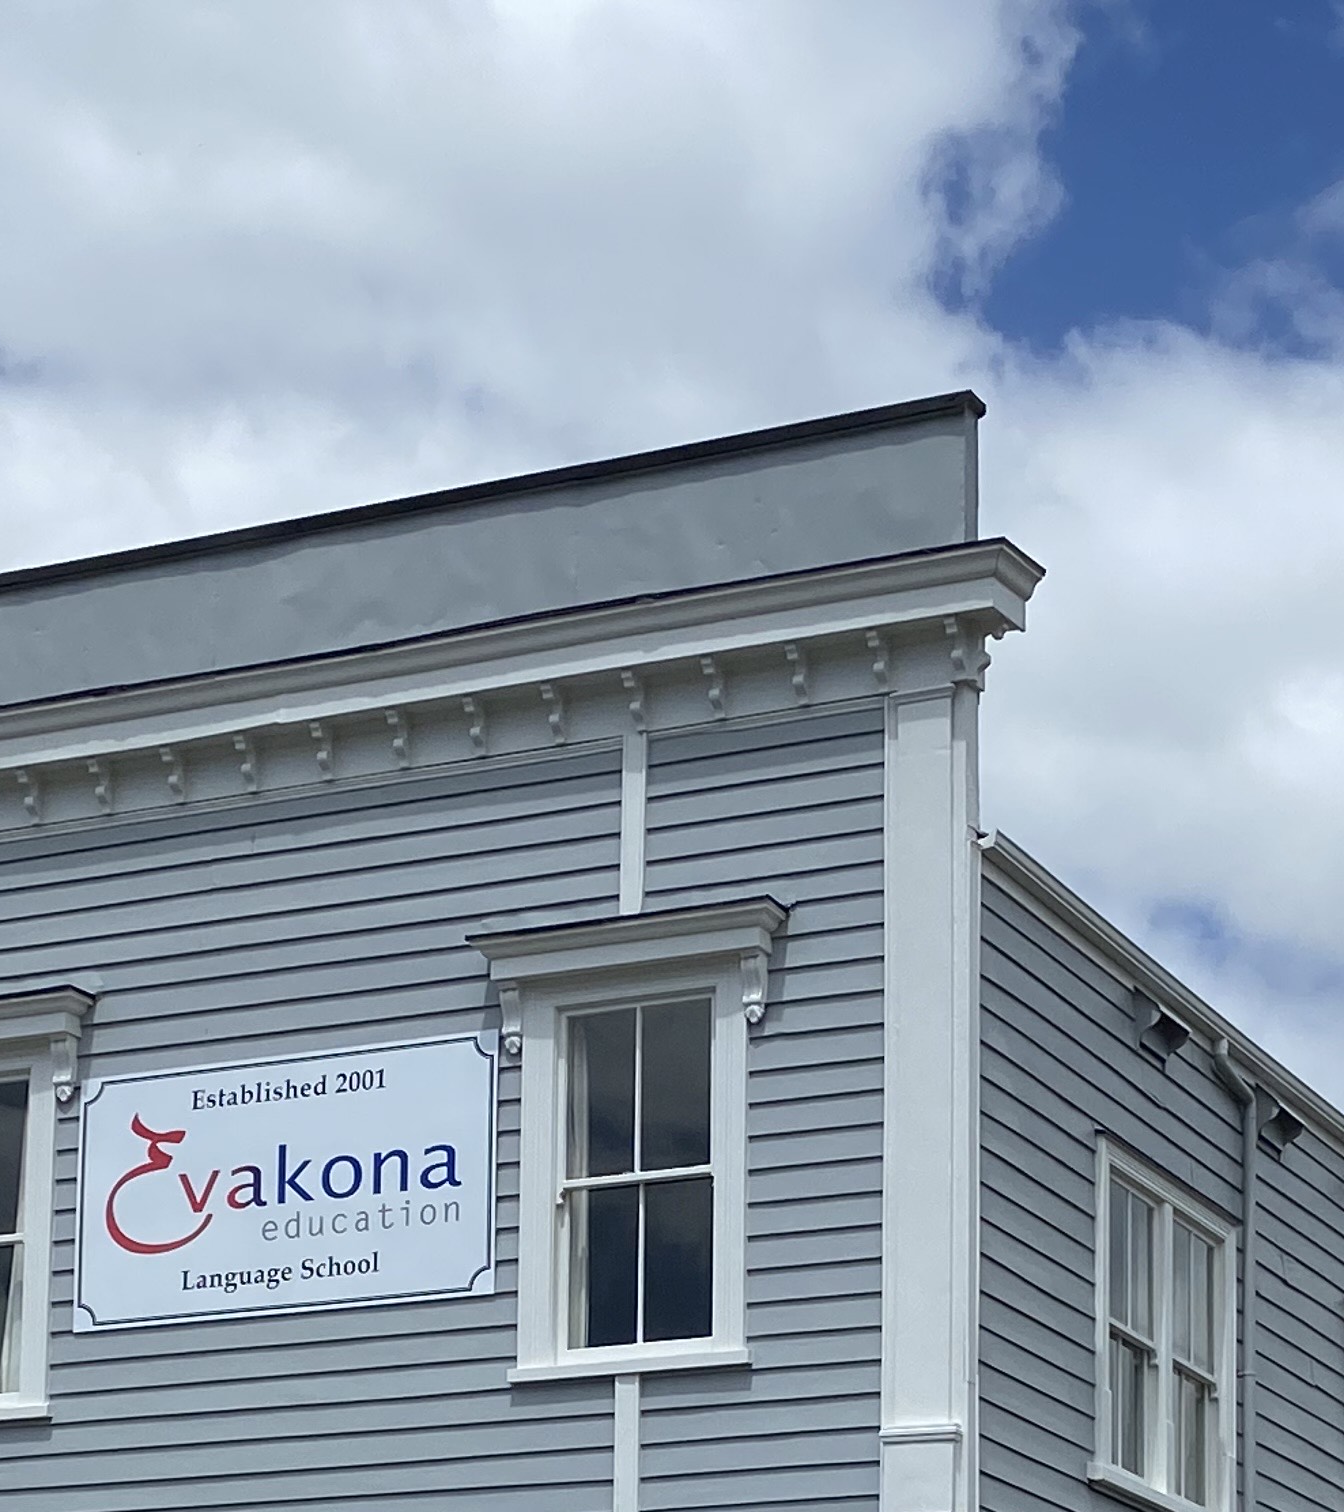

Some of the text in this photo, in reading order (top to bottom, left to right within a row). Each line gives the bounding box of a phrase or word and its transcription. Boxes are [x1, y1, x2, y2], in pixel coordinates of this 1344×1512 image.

[191, 1067, 387, 1111] Established 2001
[105, 1112, 462, 1254] Evakona
[261, 1199, 461, 1242] education
[181, 1251, 380, 1294] Language School
